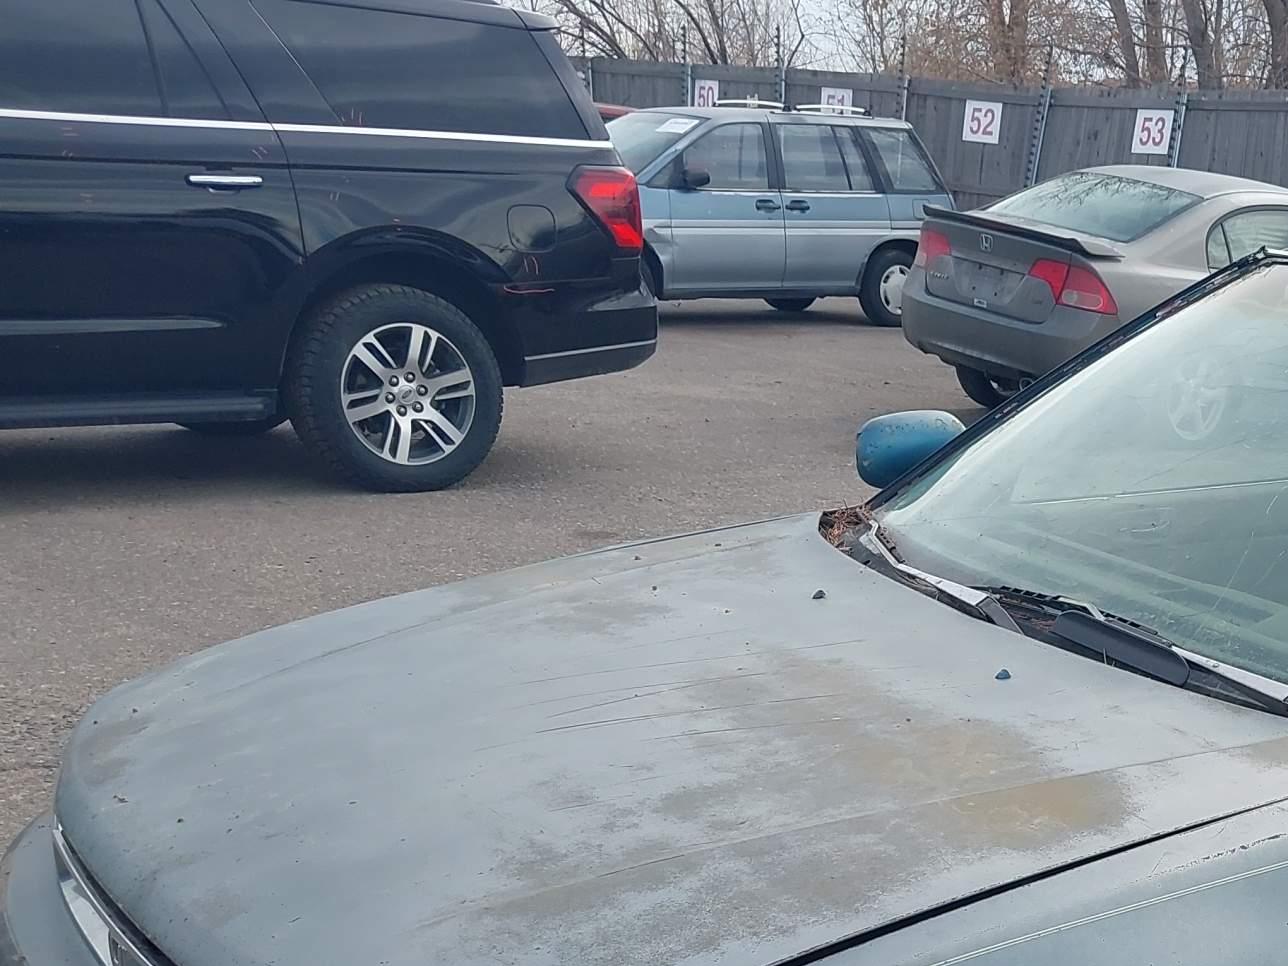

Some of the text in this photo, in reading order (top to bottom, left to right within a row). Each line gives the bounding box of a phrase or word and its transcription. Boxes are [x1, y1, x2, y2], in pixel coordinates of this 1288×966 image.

[697, 86, 714, 107] 50
[969, 107, 995, 136] 52
[1139, 116, 1166, 147] 53
